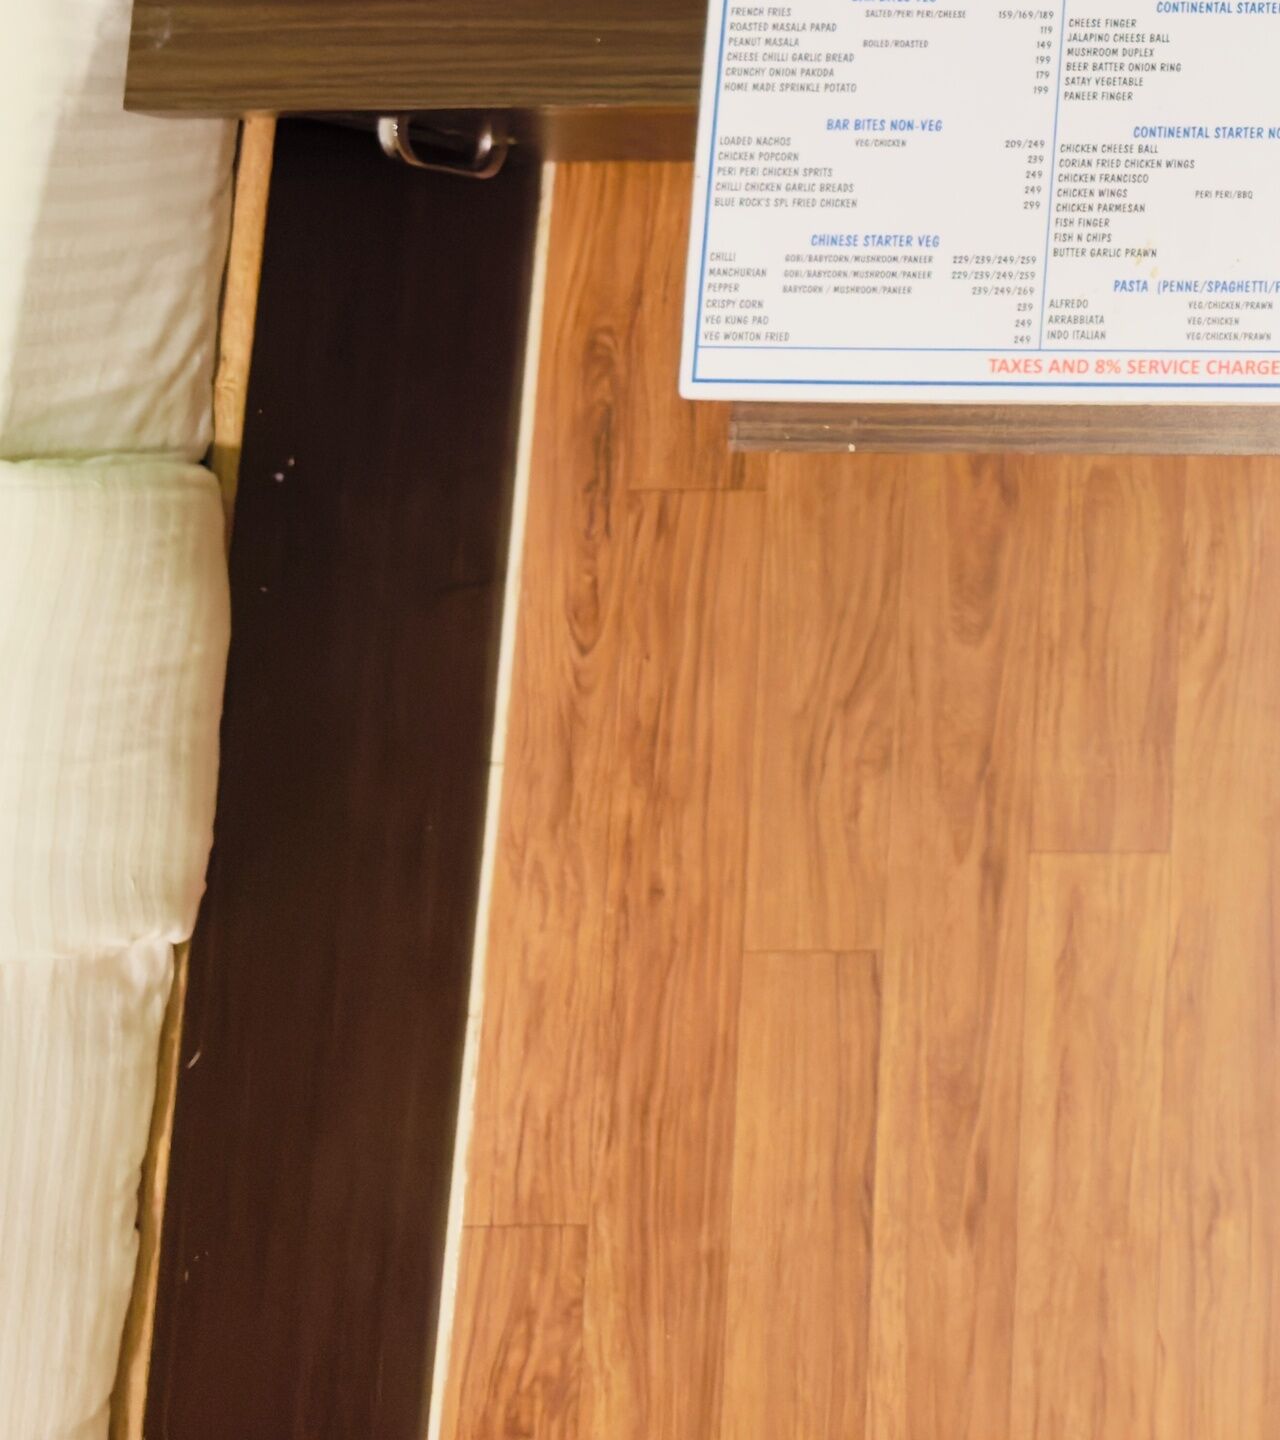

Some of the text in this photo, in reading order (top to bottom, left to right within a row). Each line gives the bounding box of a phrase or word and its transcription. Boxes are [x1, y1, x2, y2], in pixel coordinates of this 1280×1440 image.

[1156, 1, 1233, 14] CONTINENTAL
[1066, 61, 1089, 72] BEER
[1092, 62, 1125, 72] BATTER
[1128, 62, 1157, 72] ONION
[1160, 62, 1182, 72] RING
[826, 118, 943, 132] BAR BITES NON-VEG
[1133, 126, 1210, 139] CONTINENTAL
[1214, 126, 1264, 139] STARTER
[719, 136, 791, 146] LOADED NACHOS
[1056, 203, 1094, 213] CHICKEN
[1097, 203, 1146, 213] PARMESAN
[811, 234, 940, 248] CHINESE STARTER VEG
[1113, 279, 1148, 293] PASTA
[1048, 314, 1104, 324] ARRABBIATA
[988, 358, 1042, 374] TAXES
[1048, 359, 1089, 374] AND
[1095, 359, 1121, 374] 8%
[1127, 359, 1200, 375] SERVICE
